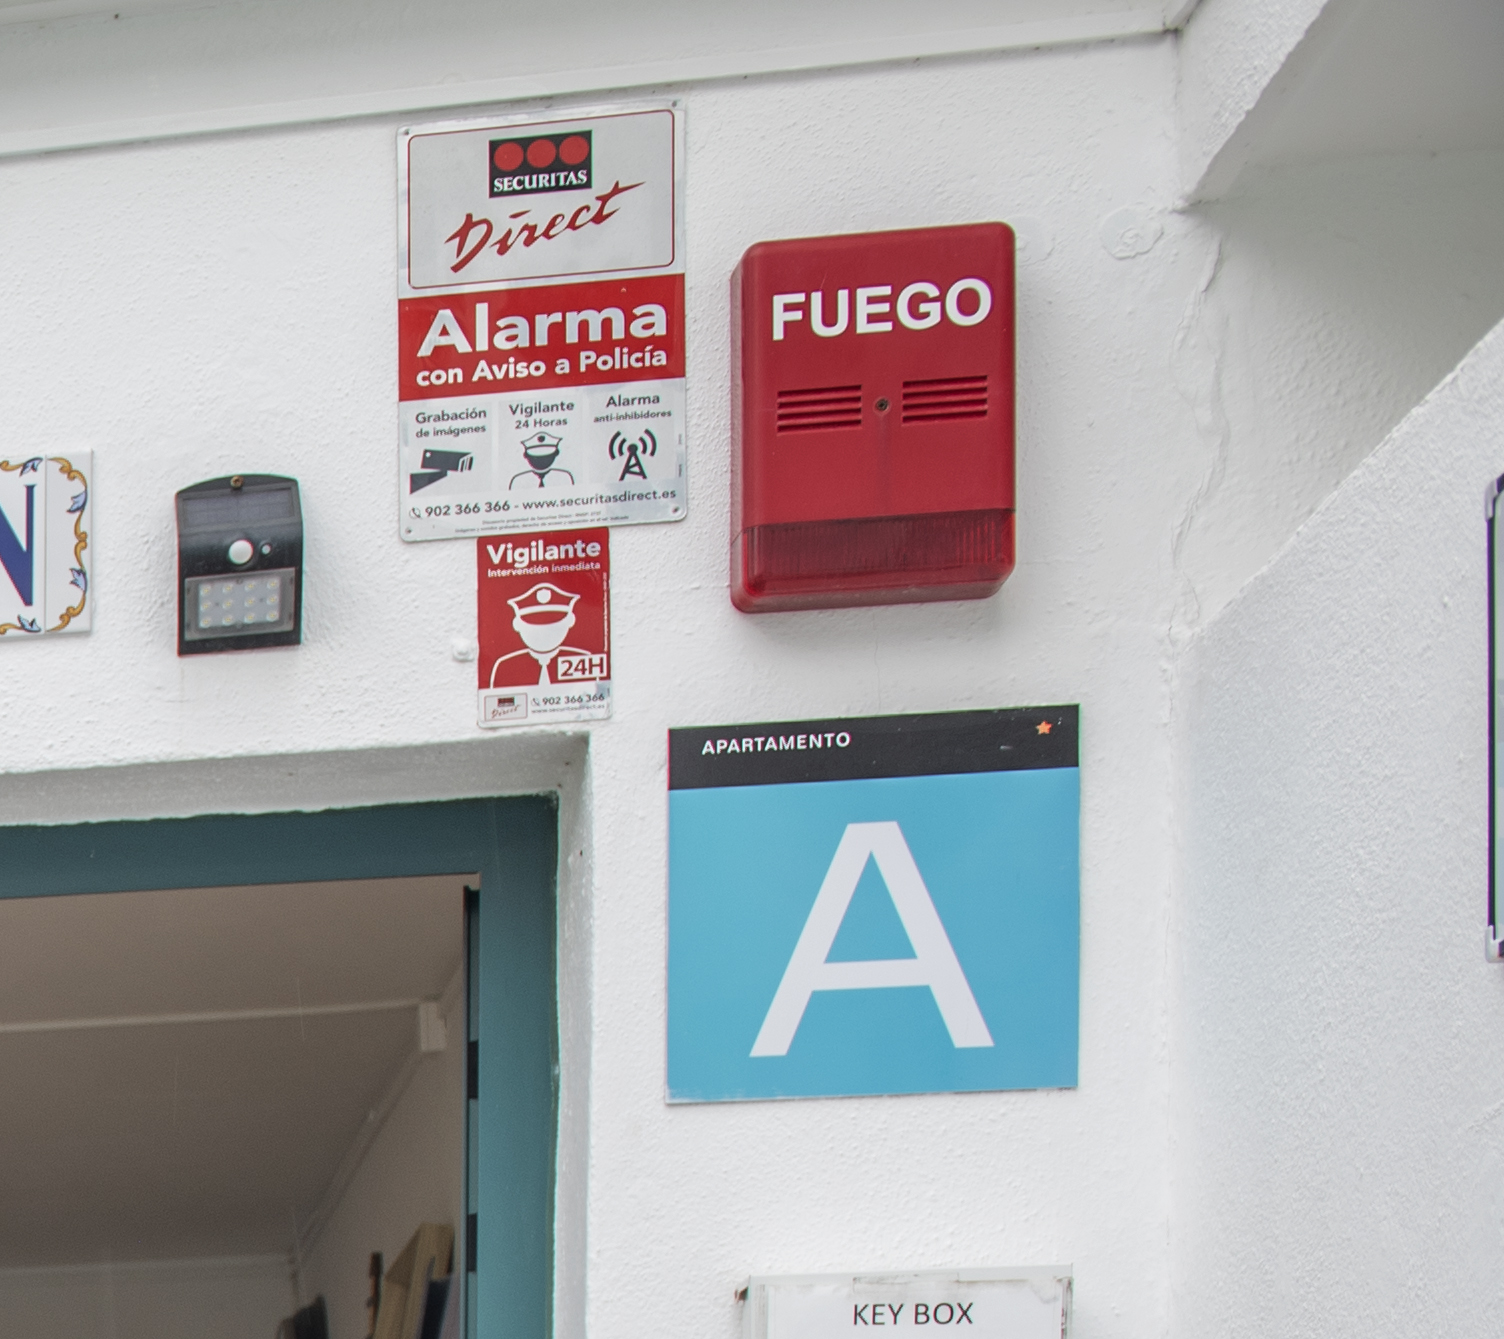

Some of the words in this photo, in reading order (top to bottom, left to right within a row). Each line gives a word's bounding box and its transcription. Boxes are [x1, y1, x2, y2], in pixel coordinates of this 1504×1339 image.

[493, 169, 588, 193] SECURITAS
[444, 180, 646, 273] Direct
[772, 277, 993, 341] FUEGO
[416, 302, 667, 357] Alarma
[416, 367, 463, 387] con
[472, 357, 546, 382] Aviso
[555, 358, 570, 375] a
[580, 345, 667, 373] Policía
[509, 401, 575, 418] Vigilante
[605, 394, 660, 408] Alarma
[415, 407, 487, 424] Grabación
[515, 419, 529, 430] 24
[533, 417, 568, 429] Horas
[594, 409, 672, 423] anti-inhibidores
[415, 427, 430, 438] de
[433, 424, 486, 439] imágenes
[425, 505, 451, 518] 902
[455, 503, 480, 516] 366
[484, 501, 510, 513] 366
[522, 489, 677, 511] www.securitasdirect.es
[487, 539, 601, 568] Vigilante
[487, 564, 548, 578] Intervención
[552, 562, 600, 573] inmediata
[560, 657, 604, 677] 24H
[701, 731, 851, 756] APARTAMENTO
[748, 820, 995, 1058] A
[853, 1303, 904, 1326] KEY
[914, 1302, 974, 1326] BOX
